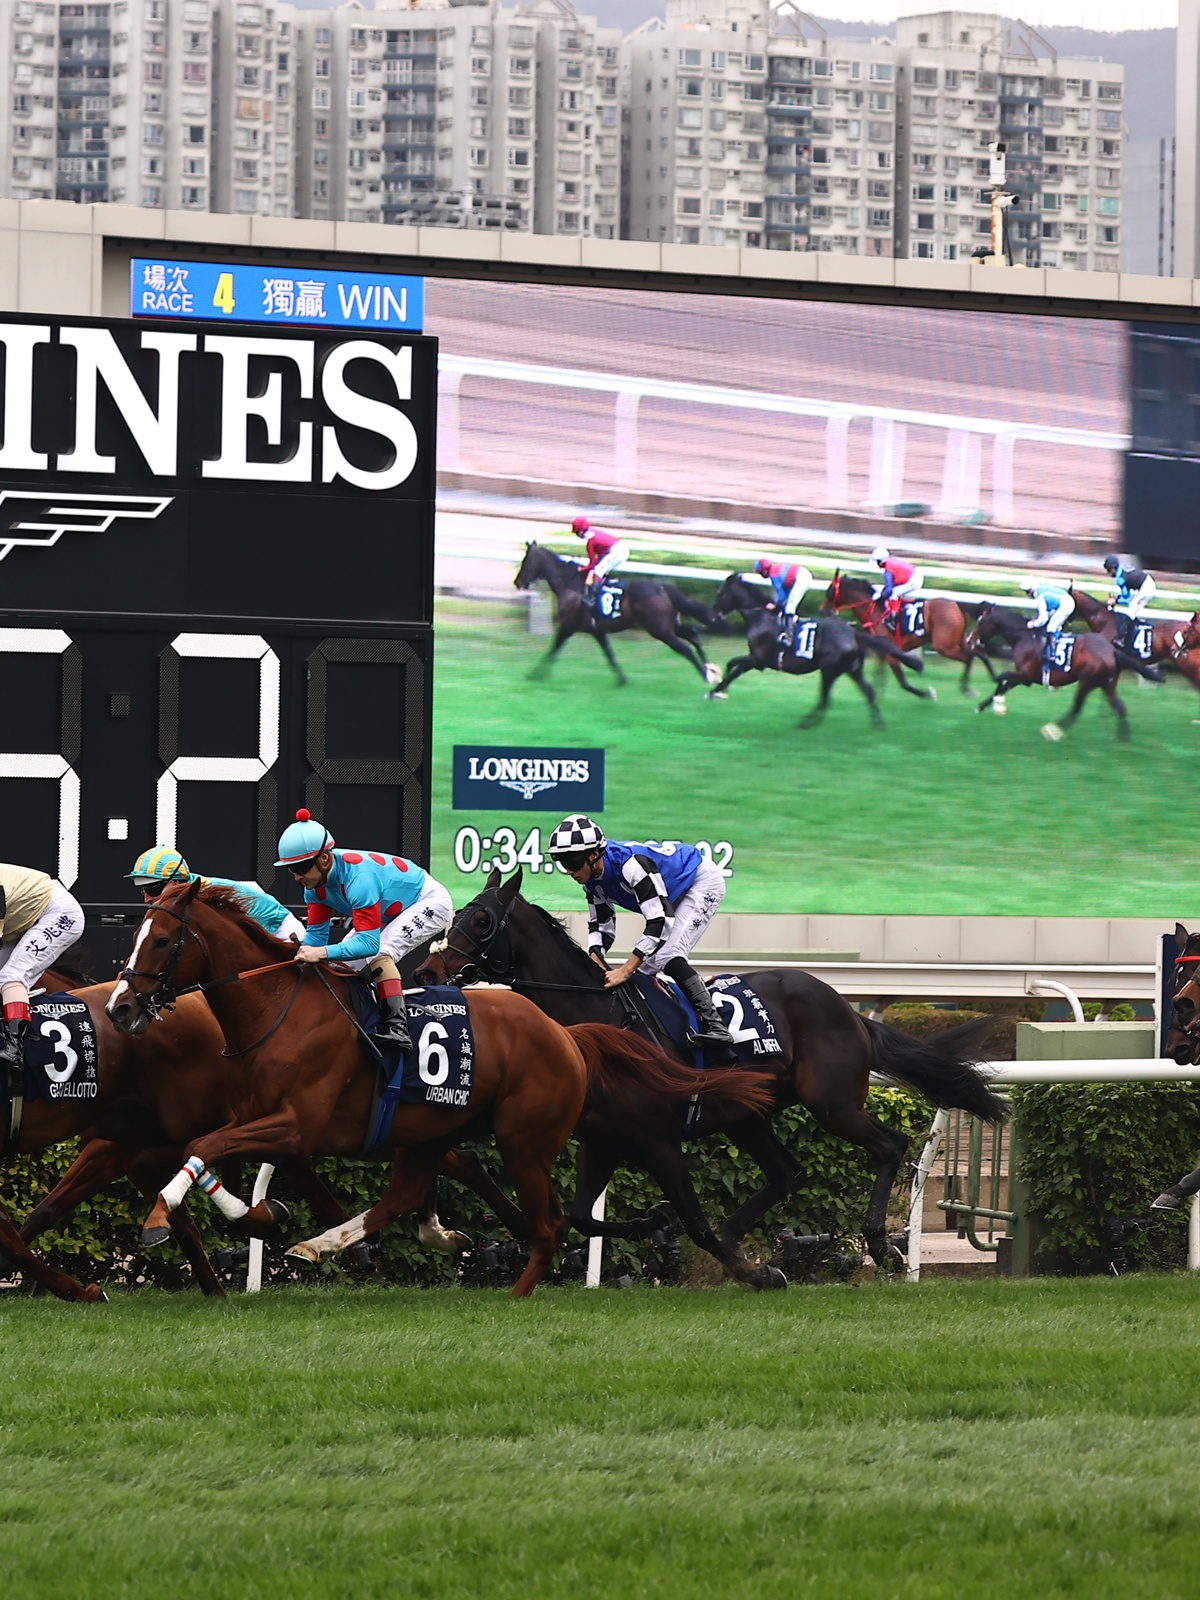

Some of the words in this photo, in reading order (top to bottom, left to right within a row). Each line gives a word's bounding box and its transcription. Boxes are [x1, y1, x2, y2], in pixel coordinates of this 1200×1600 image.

[143, 265, 190, 293] 場次
[212, 272, 236, 314] 4
[262, 278, 327, 318] 獨贏
[337, 283, 407, 322] WIN
[143, 292, 194, 313] RACE
[468, 756, 590, 783] LONGINES
[25, 915, 76, 957] 艾兆禮
[30, 1003, 86, 1014] ONGINES
[711, 991, 760, 1045] 2
[40, 1020, 79, 1083] 3
[418, 1021, 450, 1086] 6
[459, 1027, 473, 1087] 名城潮流
[753, 1039, 766, 1055] AL
[425, 1086, 455, 1105] URBAN
[454, 1088, 471, 1106] CHIC
